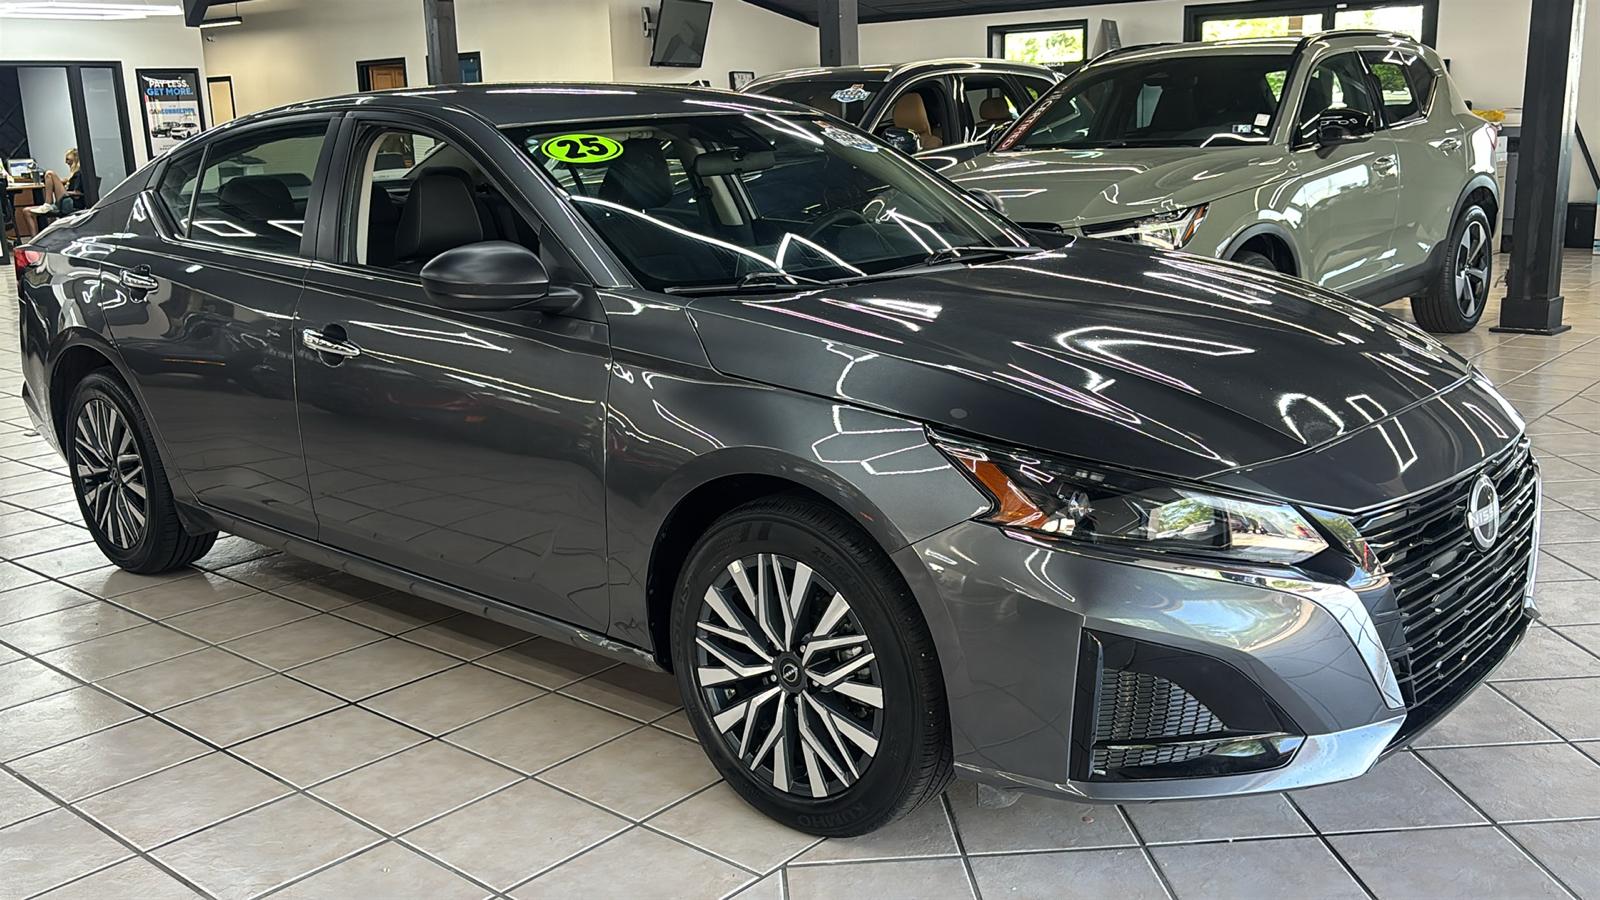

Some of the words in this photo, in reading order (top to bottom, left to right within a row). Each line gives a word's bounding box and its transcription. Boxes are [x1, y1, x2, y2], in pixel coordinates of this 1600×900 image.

[146, 88, 164, 96] GET
[165, 88, 194, 96] MORE.
[167, 80, 189, 88] LESS.
[1002, 100, 1053, 148] CERTIFIED
[556, 137, 609, 159] 25
[797, 801, 868, 828] KUMHO
